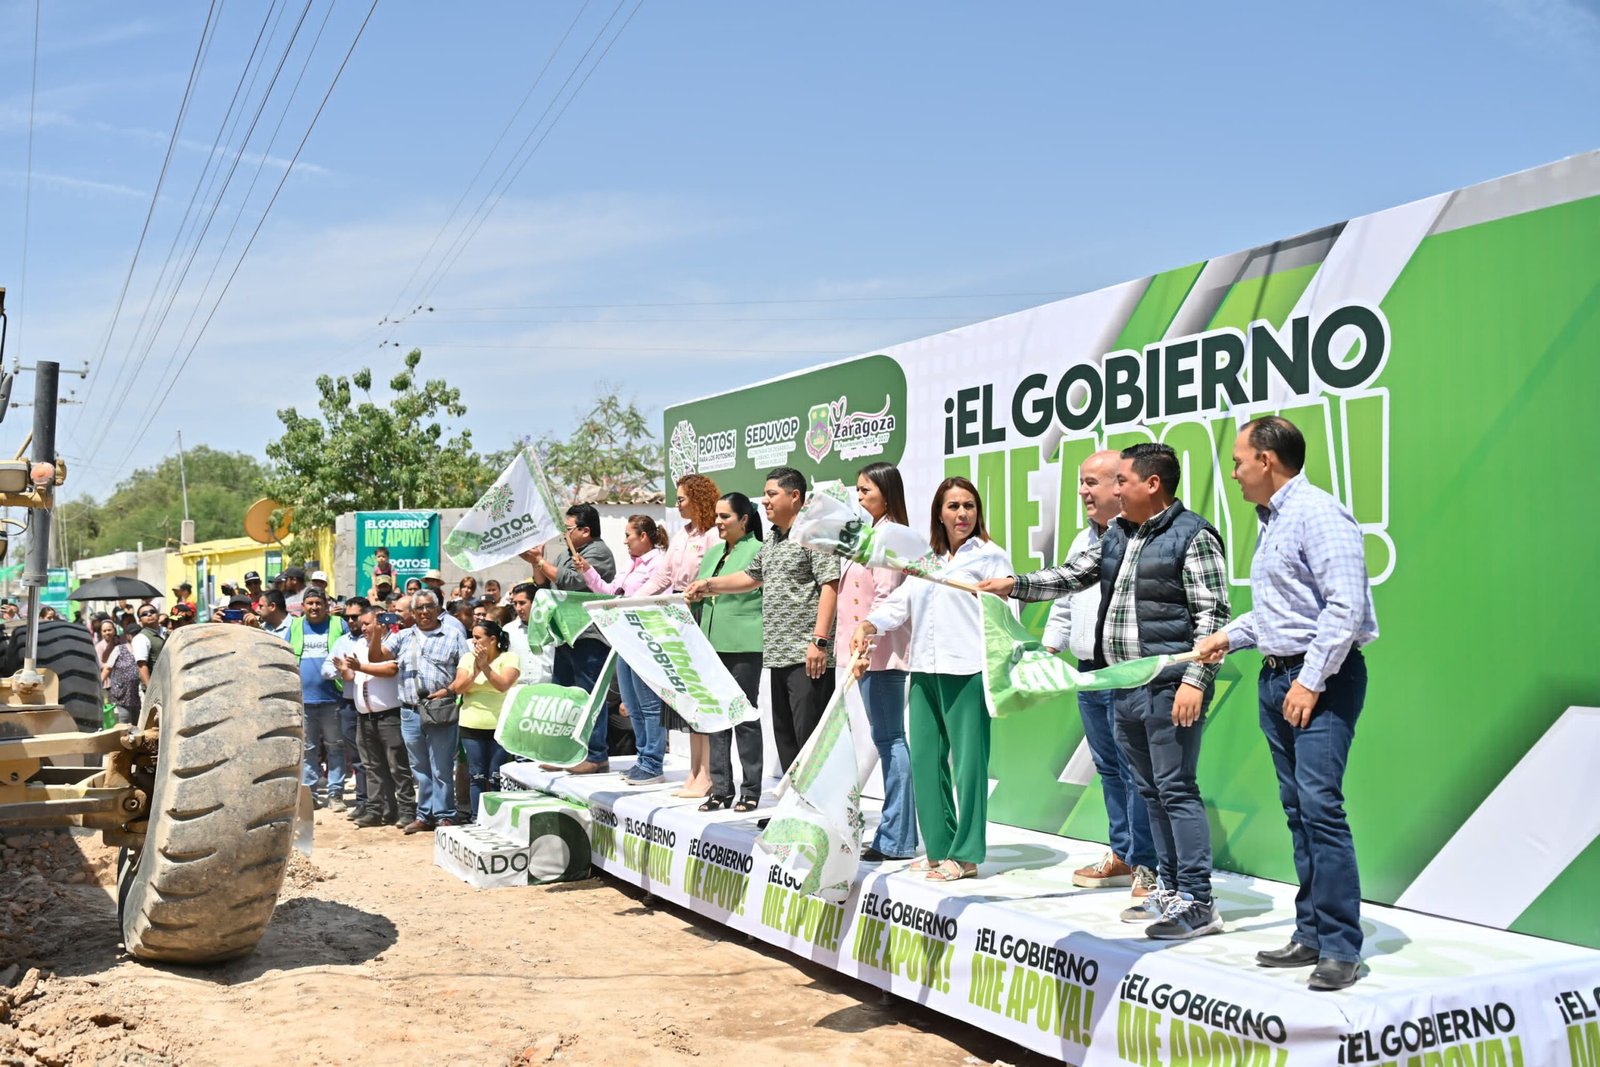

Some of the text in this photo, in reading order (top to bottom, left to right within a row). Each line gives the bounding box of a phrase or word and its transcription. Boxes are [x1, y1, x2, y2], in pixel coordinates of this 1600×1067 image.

[1012, 305, 1386, 438] GOBIERNO
[746, 419, 799, 444] SEDUVOP
[834, 417, 894, 438] Zaragoza
[365, 529, 430, 547] ME APOYA!
[378, 520, 430, 528] GOBIERNO
[448, 836, 462, 863] DEL
[463, 847, 528, 875] ESTADO
[635, 821, 676, 848] GOBIERNO
[701, 842, 754, 873] GOBIERNO
[684, 856, 750, 916] ME APOYA!
[761, 883, 845, 953] ME APOYA!
[880, 898, 958, 941] GOBIERNO
[852, 915, 956, 994] ME APOYA!
[1000, 934, 1099, 986] GOBIERNO
[968, 952, 1095, 1048] ME APOYA!
[1151, 983, 1287, 1044] GOBIERNO
[1380, 1002, 1516, 1057] GOBIERNO
